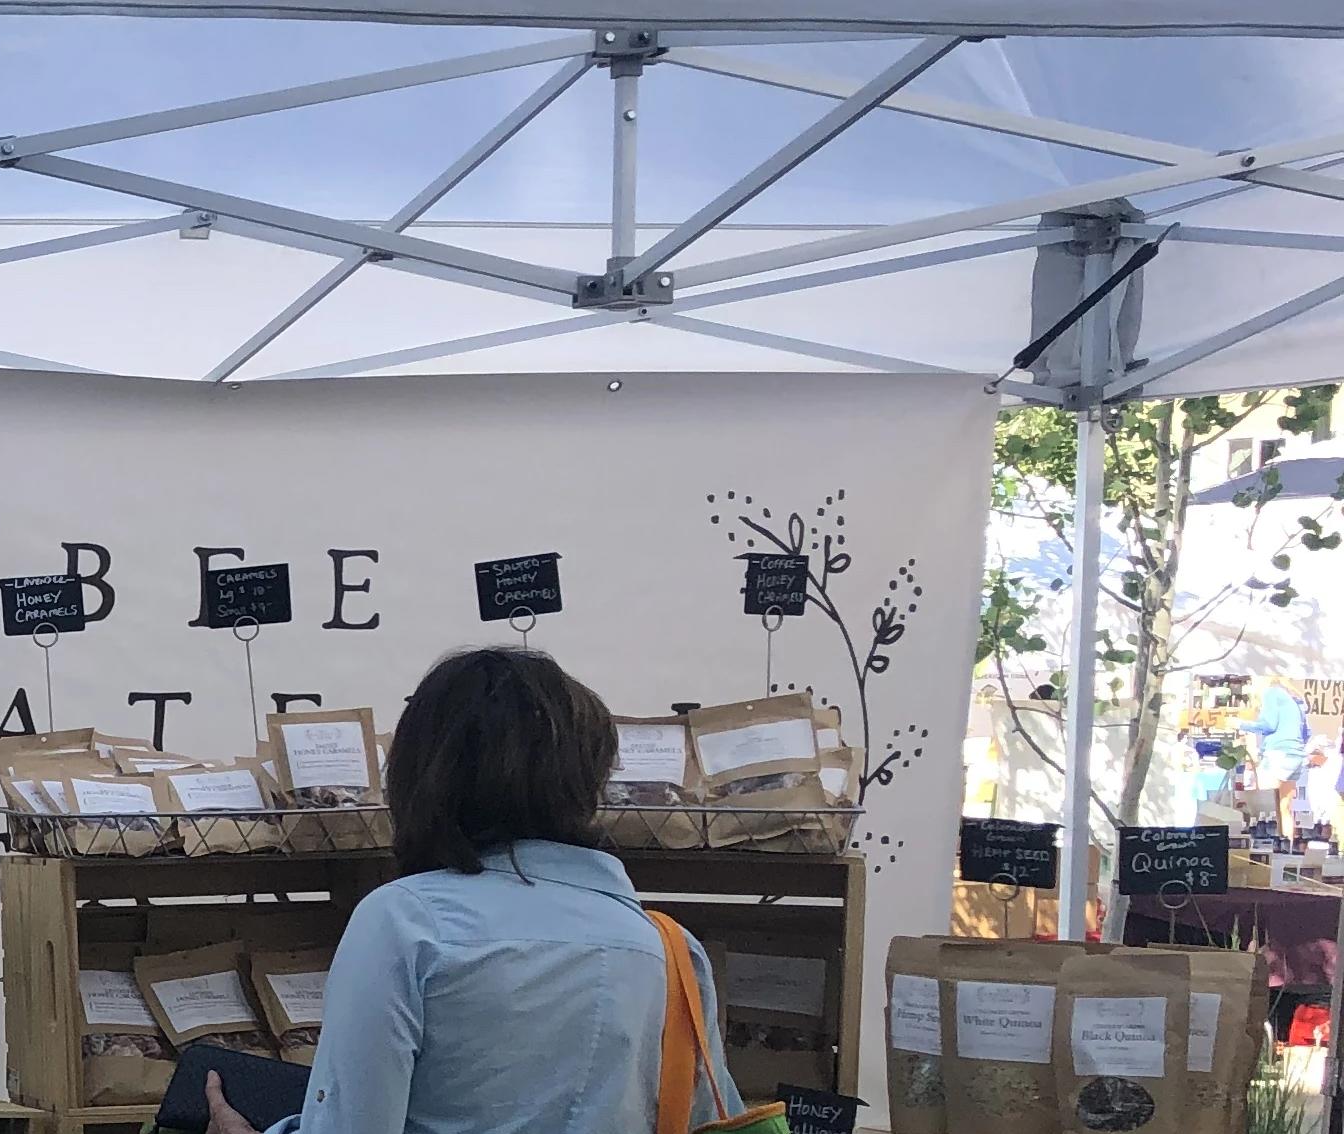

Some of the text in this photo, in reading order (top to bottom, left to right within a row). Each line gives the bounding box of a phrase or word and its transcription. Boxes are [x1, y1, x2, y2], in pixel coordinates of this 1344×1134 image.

[16, 589, 62, 608] HONEY
[15, 604, 78, 623] CARAMELS
[1304, 679, 1344, 697] MOR
[1132, 852, 1214, 874] Quinoa
[789, 1095, 843, 1124] HONEY
